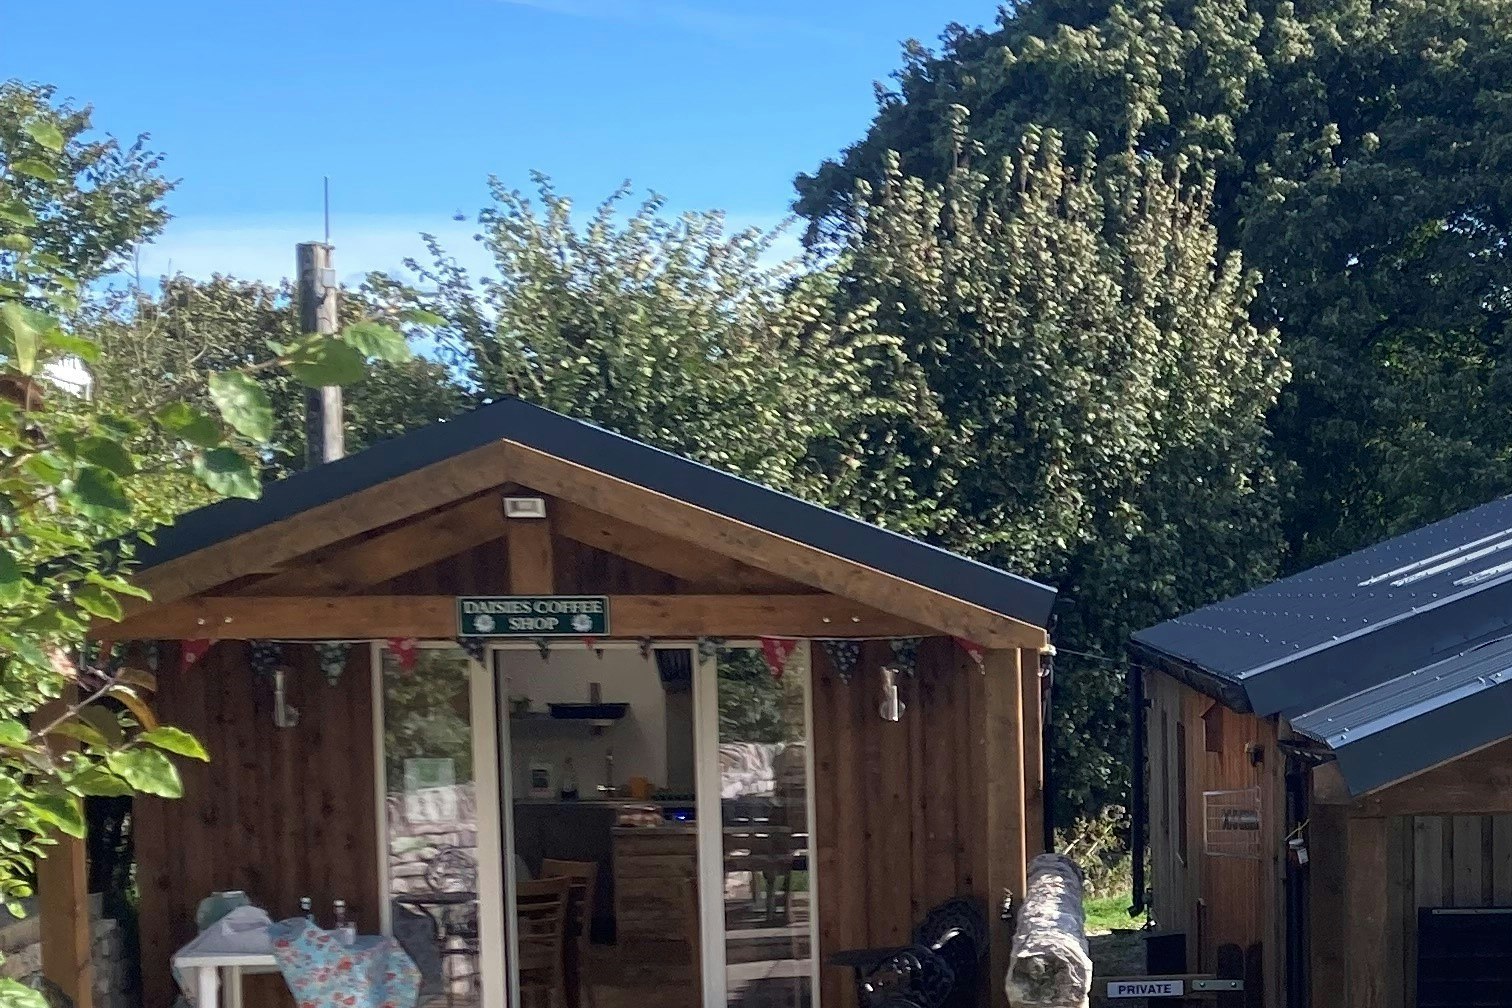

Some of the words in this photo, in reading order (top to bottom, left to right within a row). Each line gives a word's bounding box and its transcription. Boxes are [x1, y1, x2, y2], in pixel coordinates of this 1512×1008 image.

[463, 601, 532, 614] DAISIES
[533, 600, 603, 614] COFFEE
[508, 617, 559, 631] SHOP
[1118, 984, 1172, 995] PRIVATE
